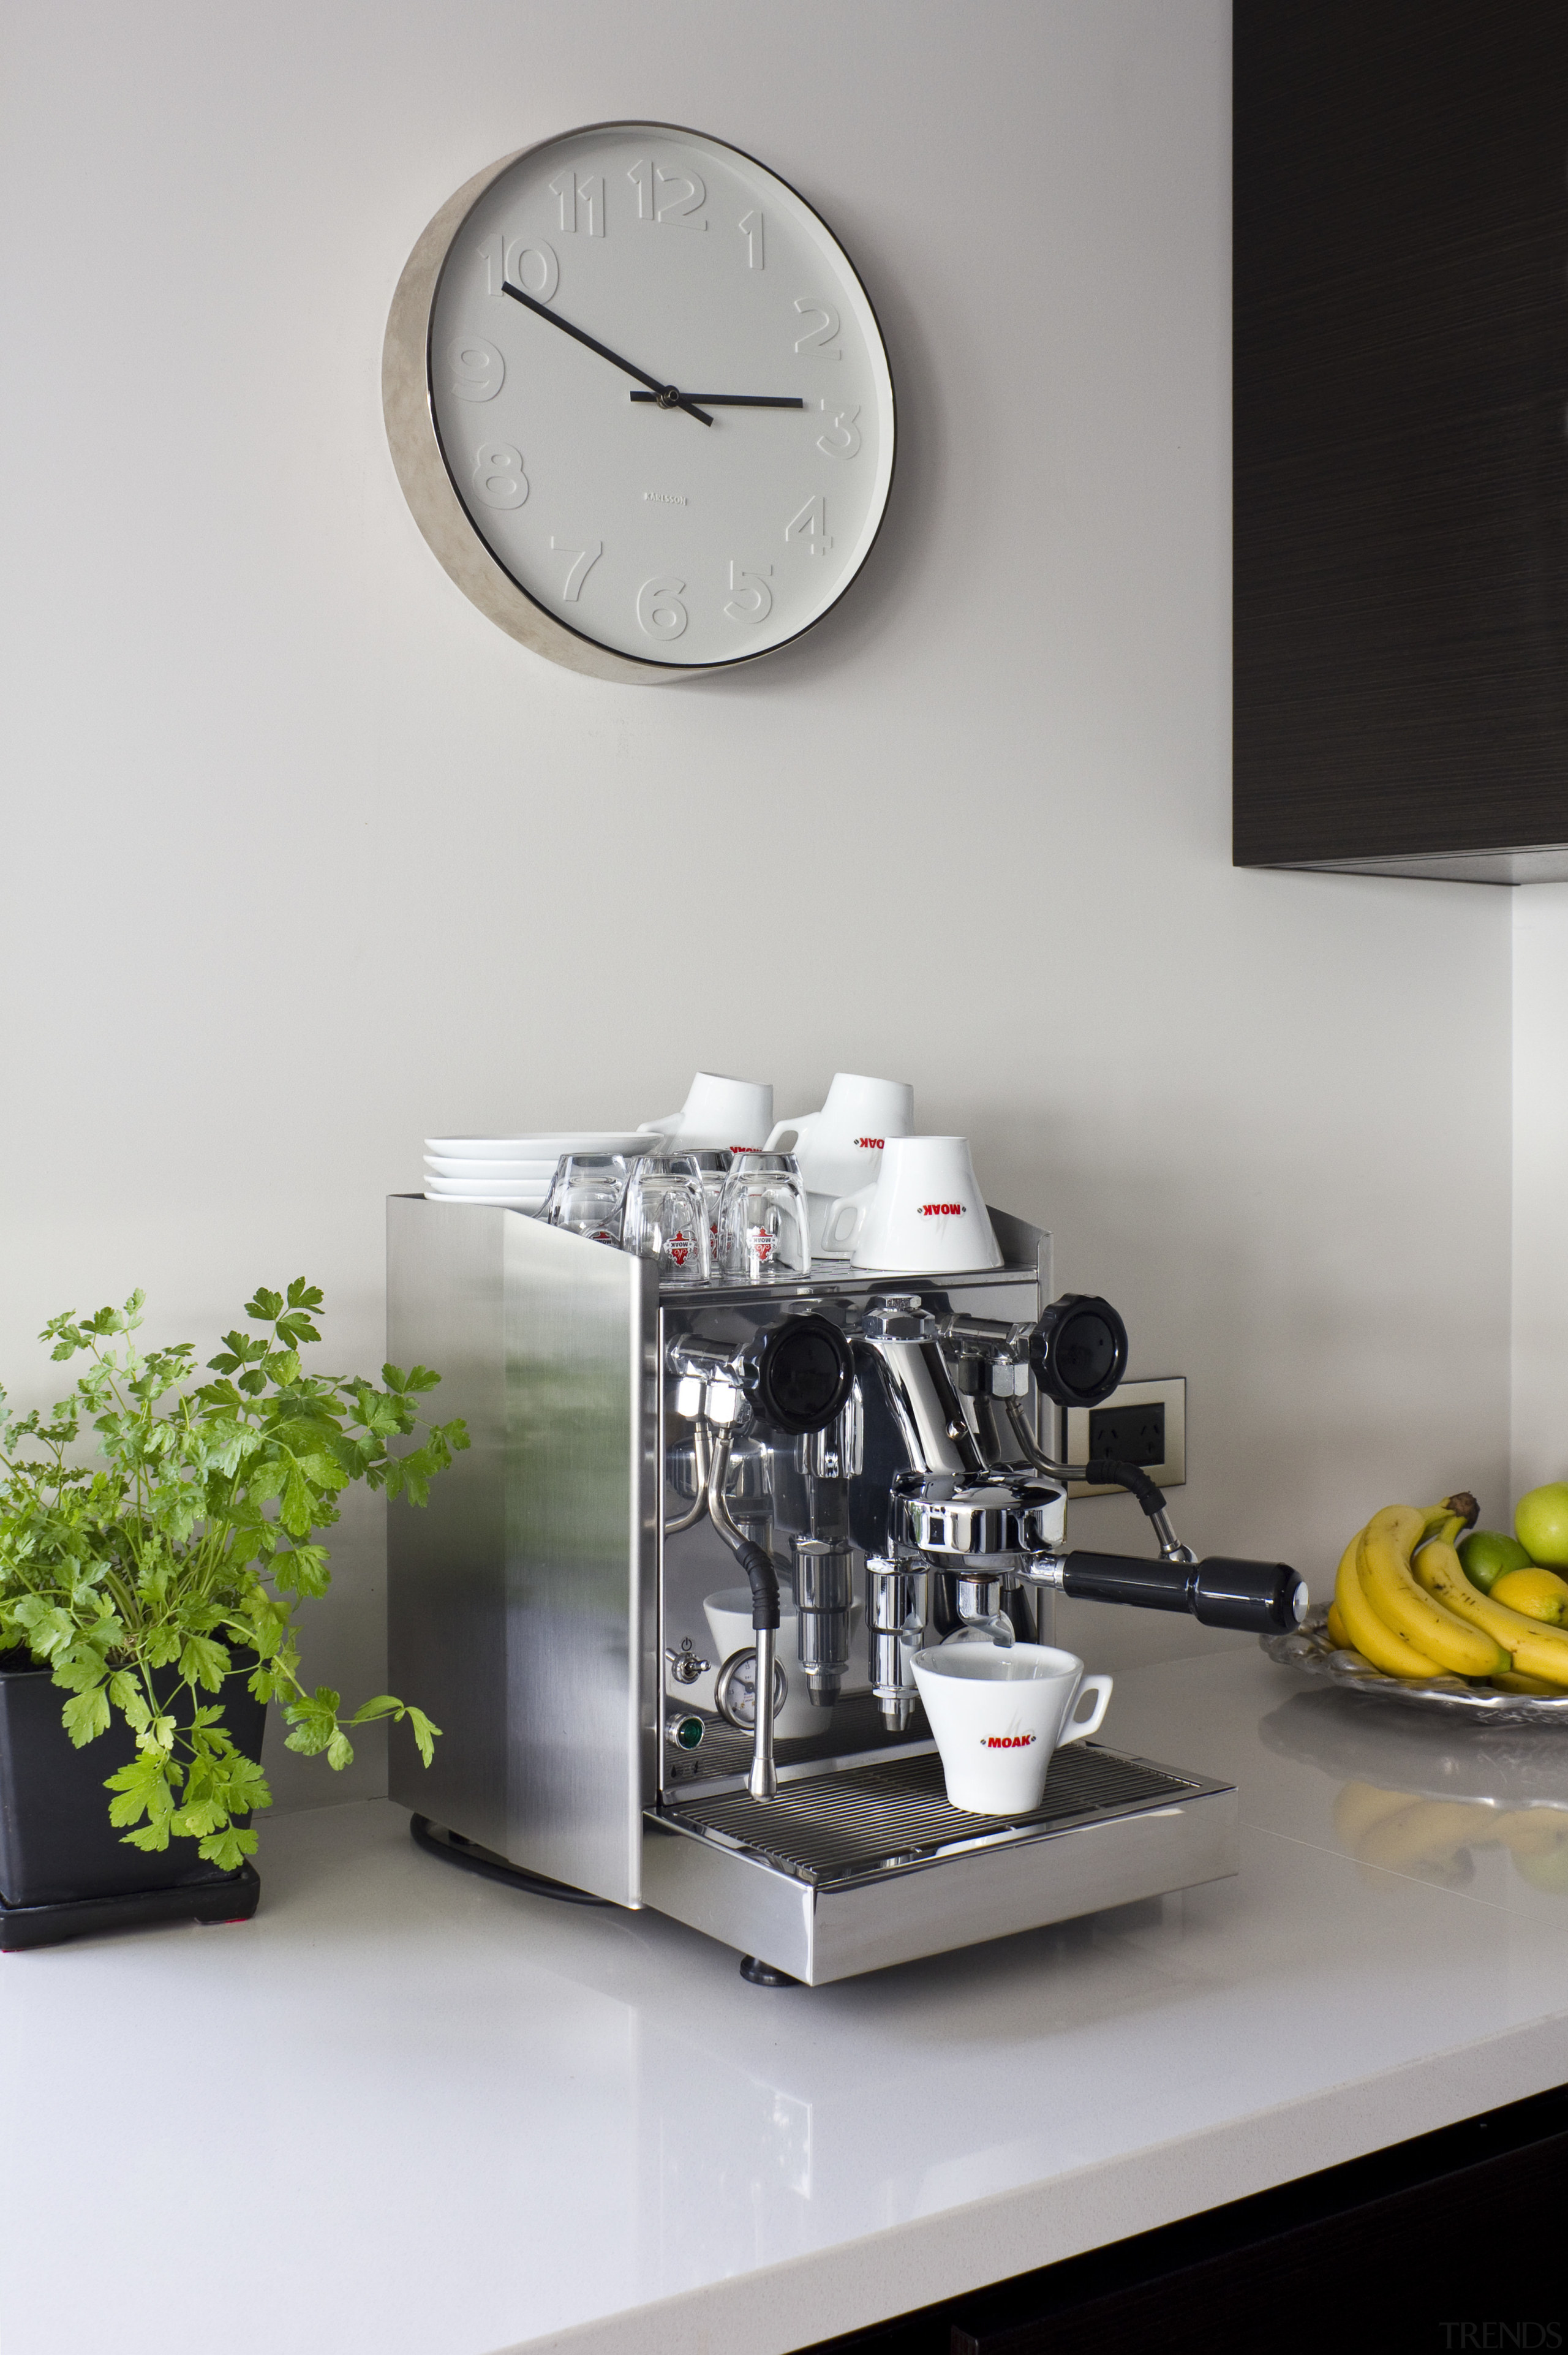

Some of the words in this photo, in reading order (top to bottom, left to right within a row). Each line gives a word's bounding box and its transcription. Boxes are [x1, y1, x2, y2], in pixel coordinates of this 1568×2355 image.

[549, 171, 605, 238] 11
[627, 160, 707, 231] 12
[478, 233, 559, 306] 10
[739, 211, 764, 270] 1
[794, 297, 841, 360] 2
[447, 336, 505, 402] 9
[816, 398, 862, 459] 3
[472, 442, 529, 510] 8
[644, 492, 687, 506] KARLSSON
[785, 495, 832, 556] 4
[551, 535, 603, 602] 7
[723, 560, 773, 624] 5
[636, 576, 688, 641] 6
[859, 1138, 884, 1149] OAK
[922, 1204, 960, 1216] MOAK
[987, 1734, 1031, 1748] MOAK
